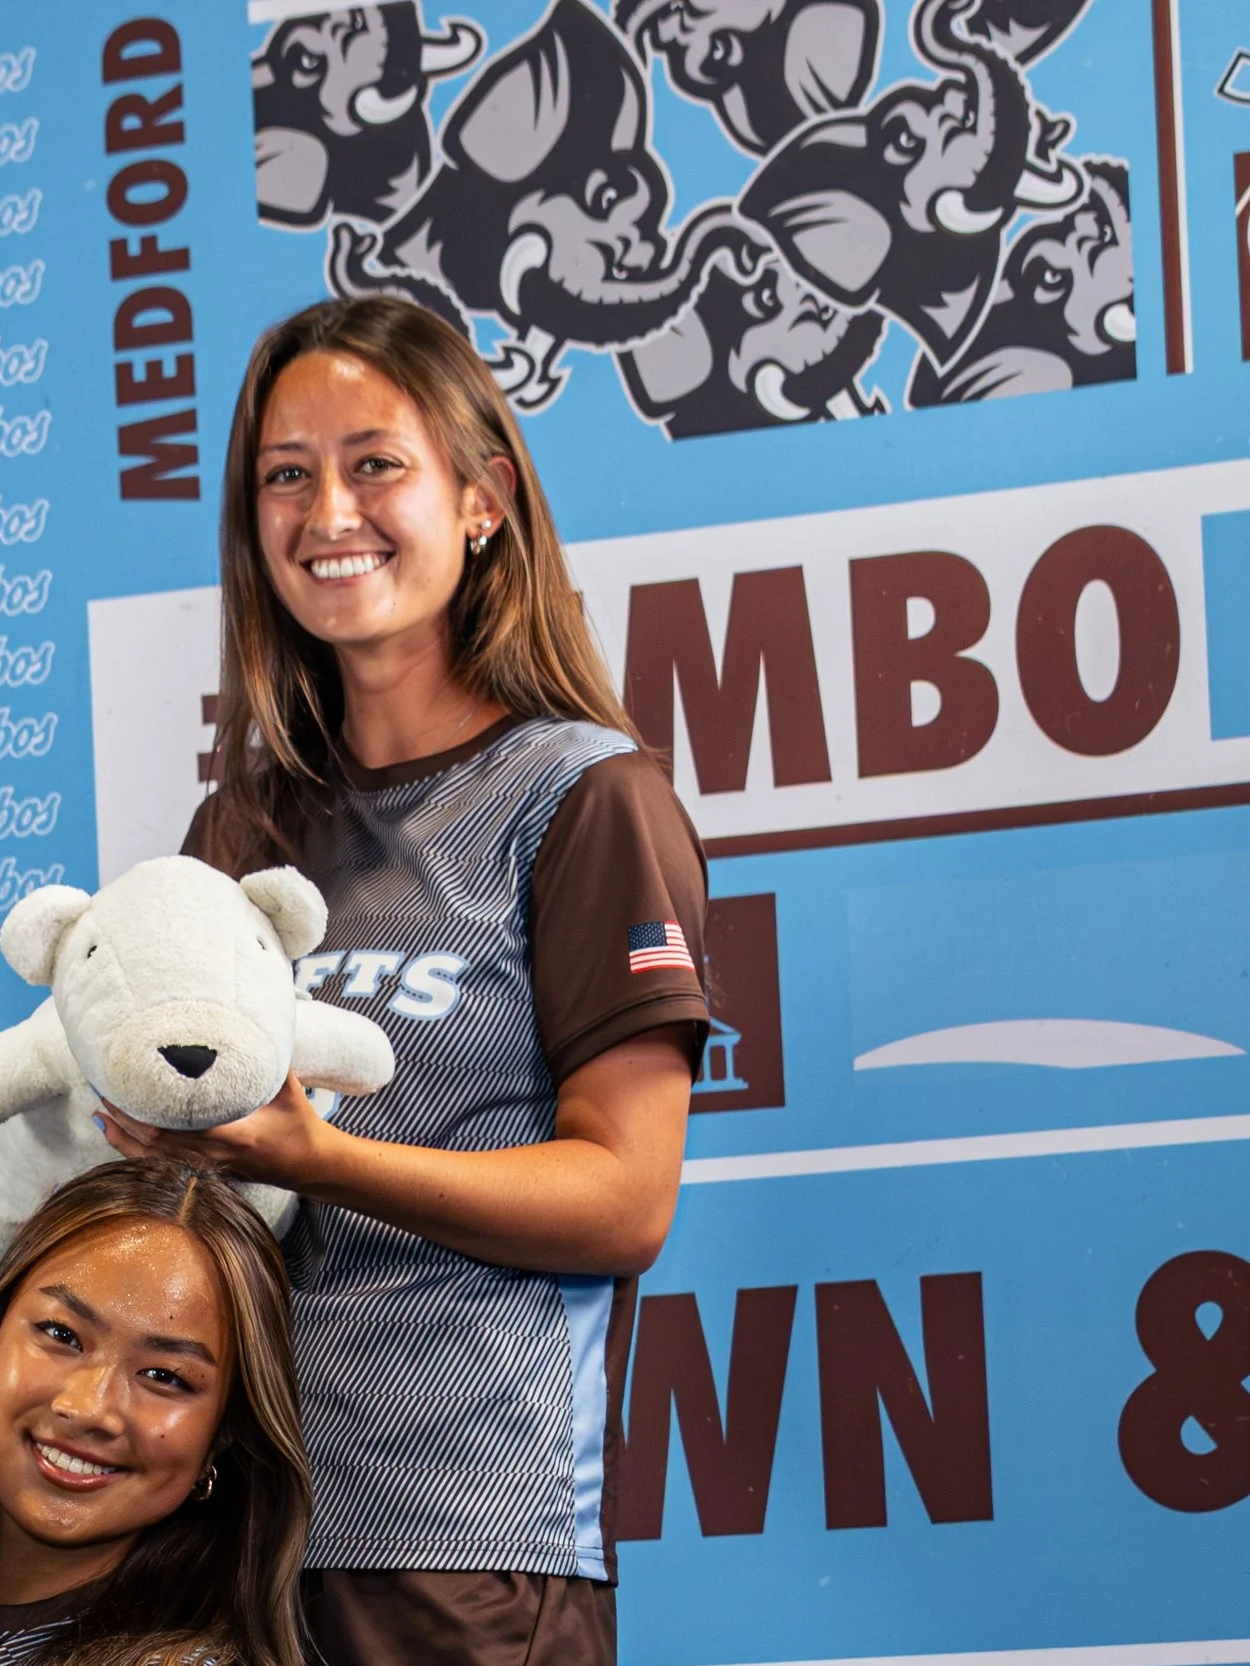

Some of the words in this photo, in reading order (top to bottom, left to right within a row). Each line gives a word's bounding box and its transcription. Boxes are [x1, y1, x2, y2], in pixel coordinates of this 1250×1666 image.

[101, 15, 202, 501] MEDFORD
[294, 949, 471, 1022] FTS
[616, 1271, 995, 1542] WN
[1117, 1249, 1250, 1514] &
